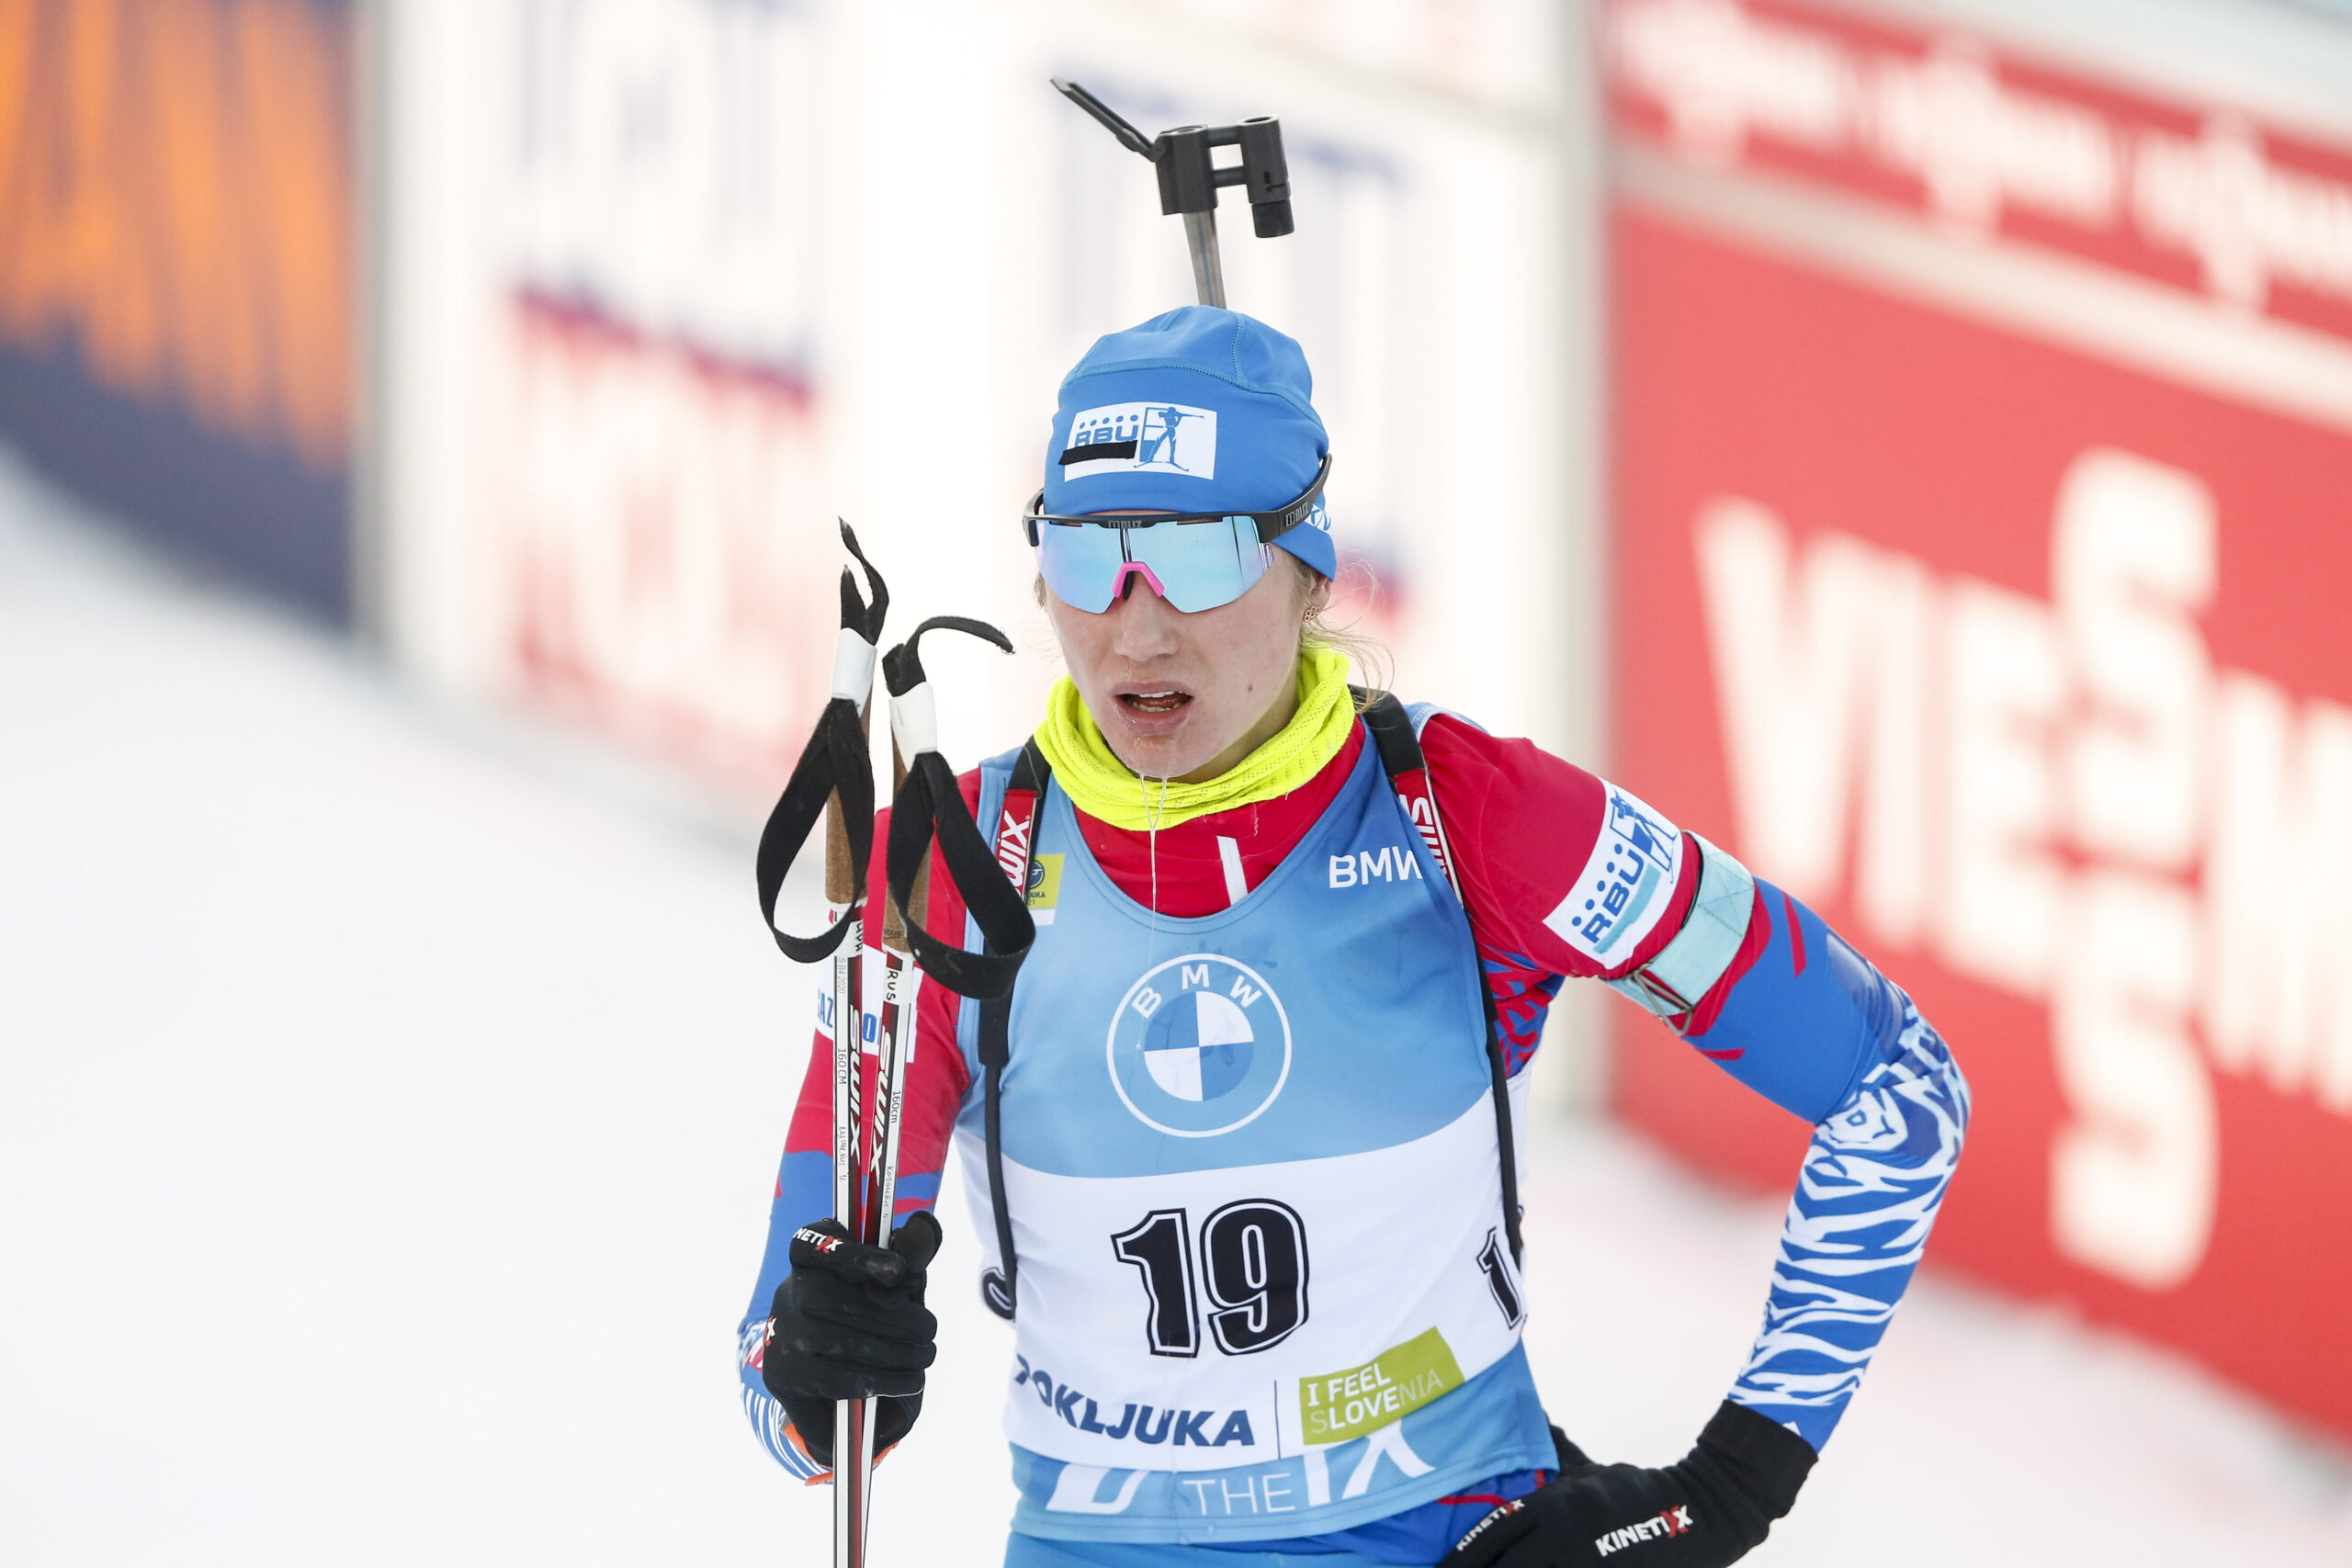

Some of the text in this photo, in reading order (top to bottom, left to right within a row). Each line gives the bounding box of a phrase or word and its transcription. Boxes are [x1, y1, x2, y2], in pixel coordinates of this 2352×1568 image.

[1075, 425, 1139, 447] RBU
[1121, 520, 1143, 529] BLIZ
[1295, 502, 1309, 522] BLIZ
[998, 809, 1030, 897] WIX
[1329, 845, 1423, 888] BMW
[1580, 849, 1645, 943] RBU
[886, 970, 899, 1001] RUS
[1131, 963, 1262, 1019] BMW
[837, 1048, 847, 1085] 160 CM
[870, 1024, 891, 1187] SWIX
[890, 1090, 901, 1123] 160cm
[1110, 1198, 1310, 1359] 19
[1476, 1225, 1526, 1330] 1
[1307, 1363, 1391, 1407] I FEEL
[1310, 1369, 1443, 1434] SLOVENIA
[1182, 1473, 1296, 1516] THE
